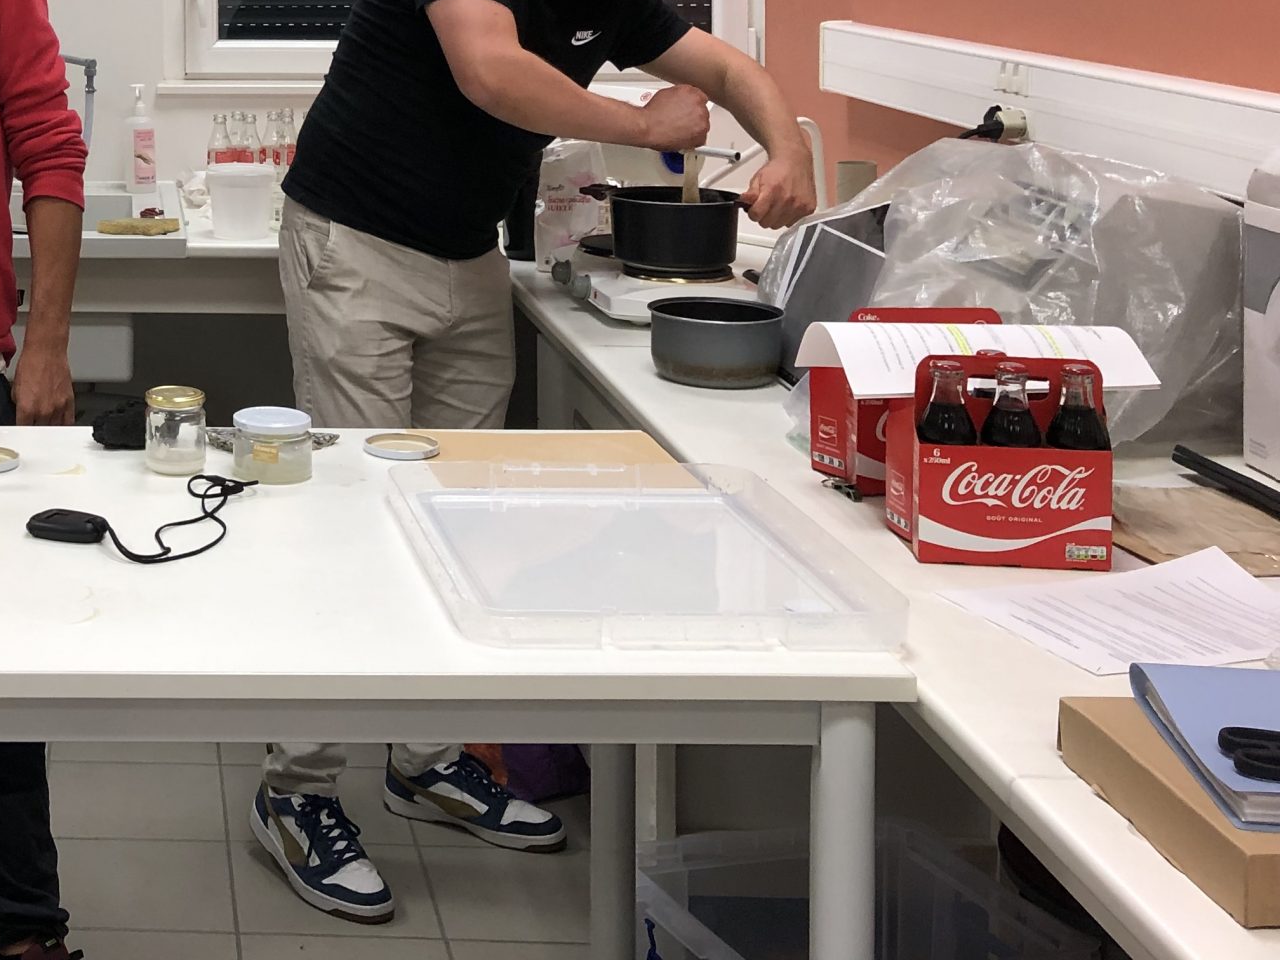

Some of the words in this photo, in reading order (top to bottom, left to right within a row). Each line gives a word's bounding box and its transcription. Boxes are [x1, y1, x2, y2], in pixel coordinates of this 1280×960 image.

[576, 30, 593, 40] NIKE
[858, 313, 878, 321] Coke
[933, 448, 940, 456] 6
[941, 461, 1095, 511] Coca-Cola
